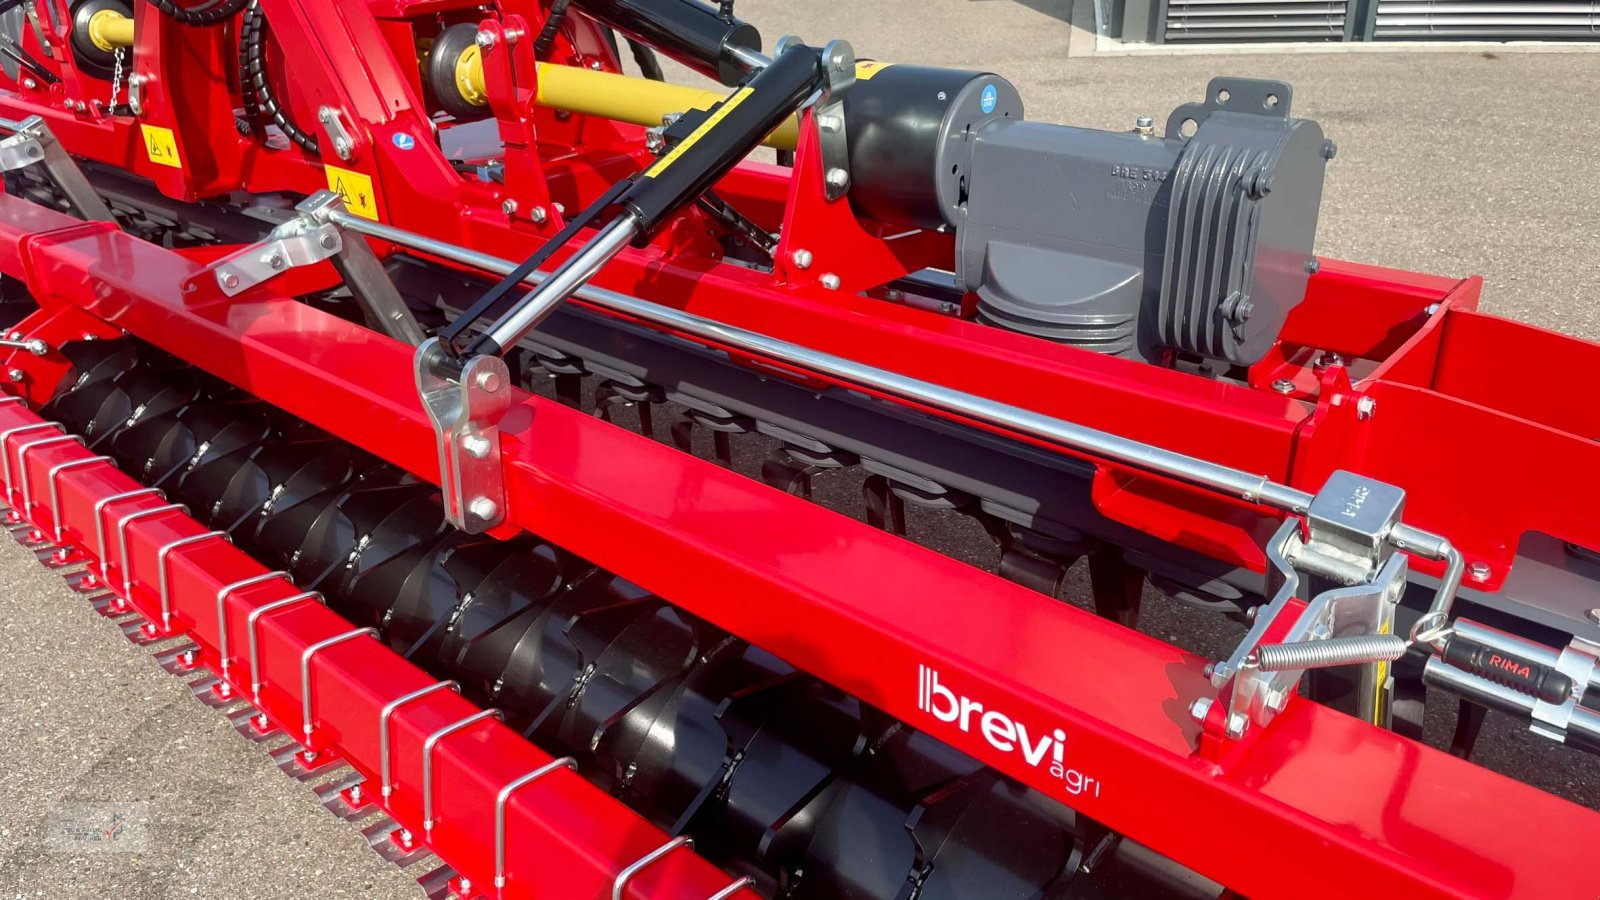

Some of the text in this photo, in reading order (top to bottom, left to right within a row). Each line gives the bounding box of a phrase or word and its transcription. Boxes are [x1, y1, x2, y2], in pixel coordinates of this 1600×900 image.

[1489, 654, 1530, 679] RIMA
[918, 663, 1066, 767] brevi
[1050, 760, 1100, 798] agri
